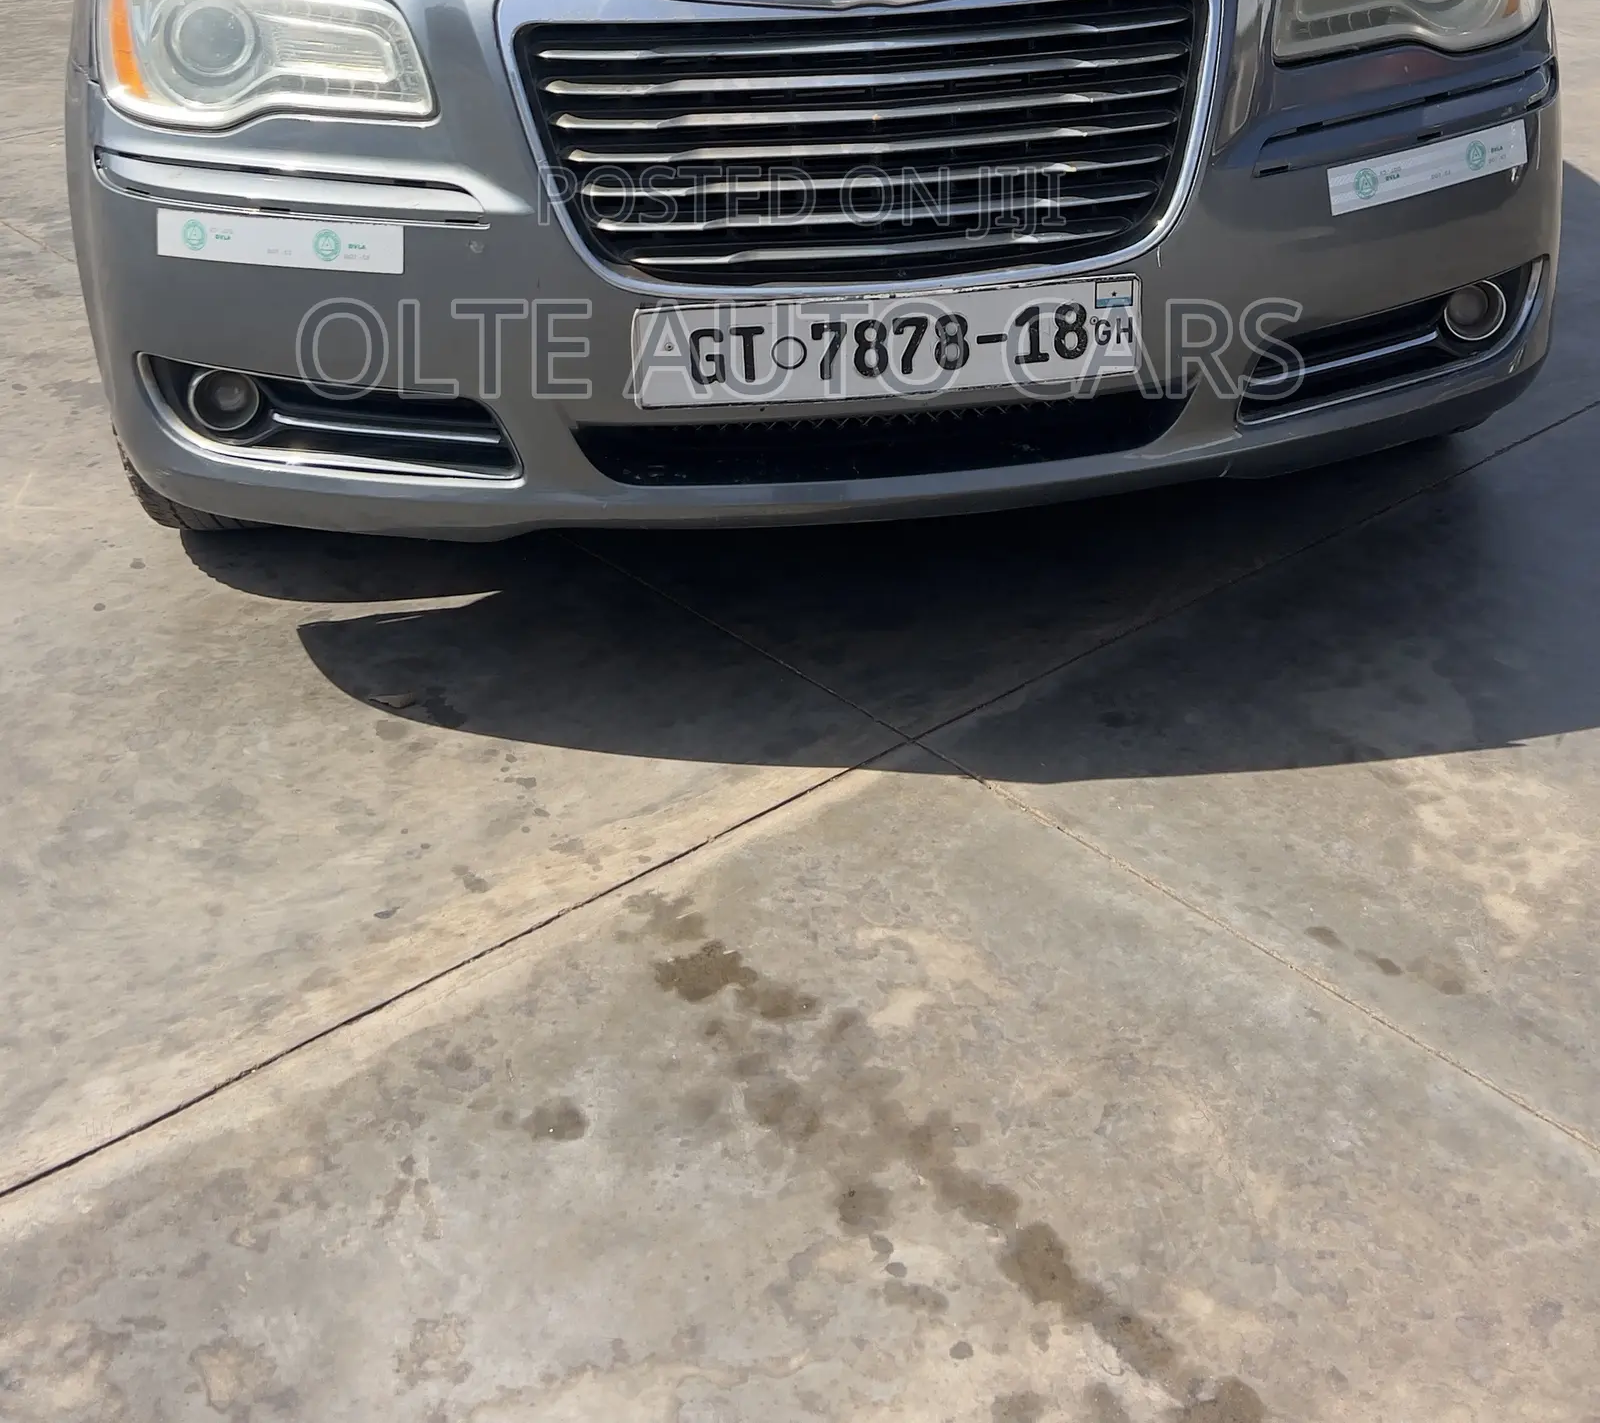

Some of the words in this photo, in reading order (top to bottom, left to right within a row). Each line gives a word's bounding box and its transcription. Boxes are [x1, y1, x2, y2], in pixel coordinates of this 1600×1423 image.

[689, 325, 765, 385] GT
[811, 303, 1088, 380] 7878-18
[1095, 317, 1133, 346] GH
